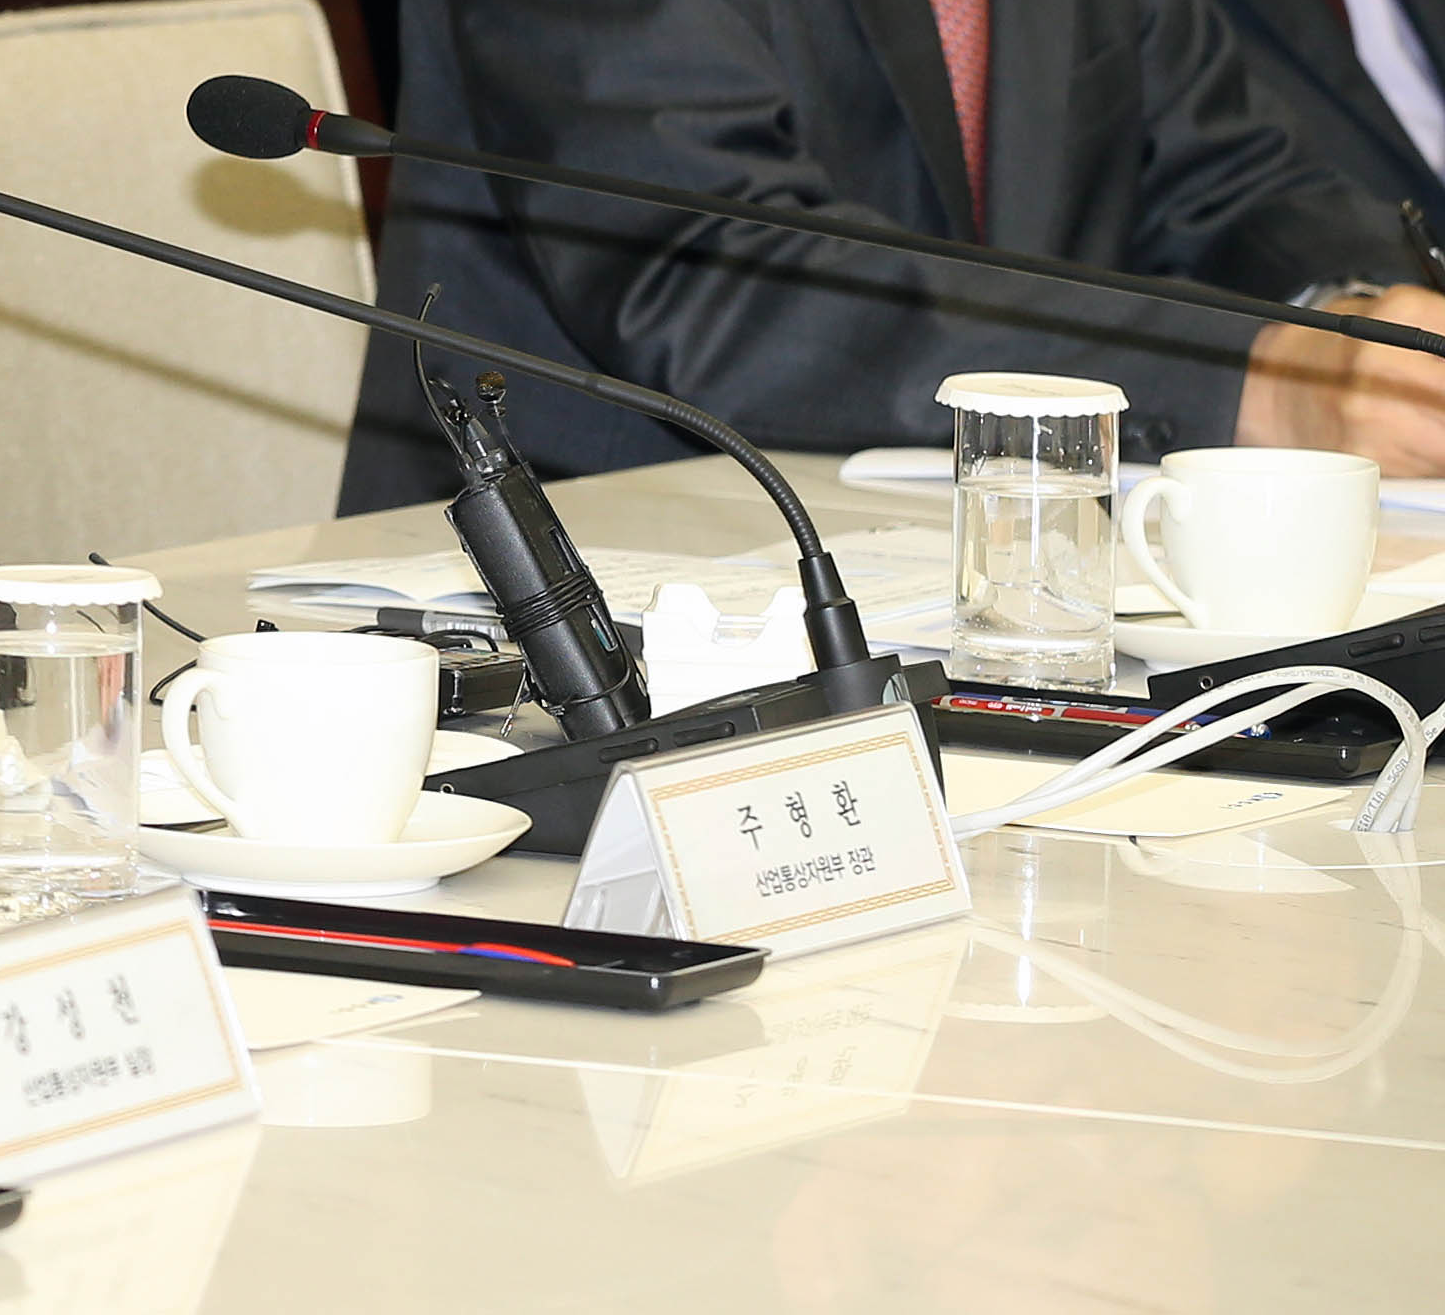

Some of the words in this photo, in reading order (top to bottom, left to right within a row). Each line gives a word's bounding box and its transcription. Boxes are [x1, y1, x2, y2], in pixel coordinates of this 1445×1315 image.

[737, 805, 763, 850] 주
[785, 791, 812, 838] 형
[831, 780, 861, 826] 환
[756, 853, 845, 896] 산업통상자원부
[848, 845, 875, 875] 장관
